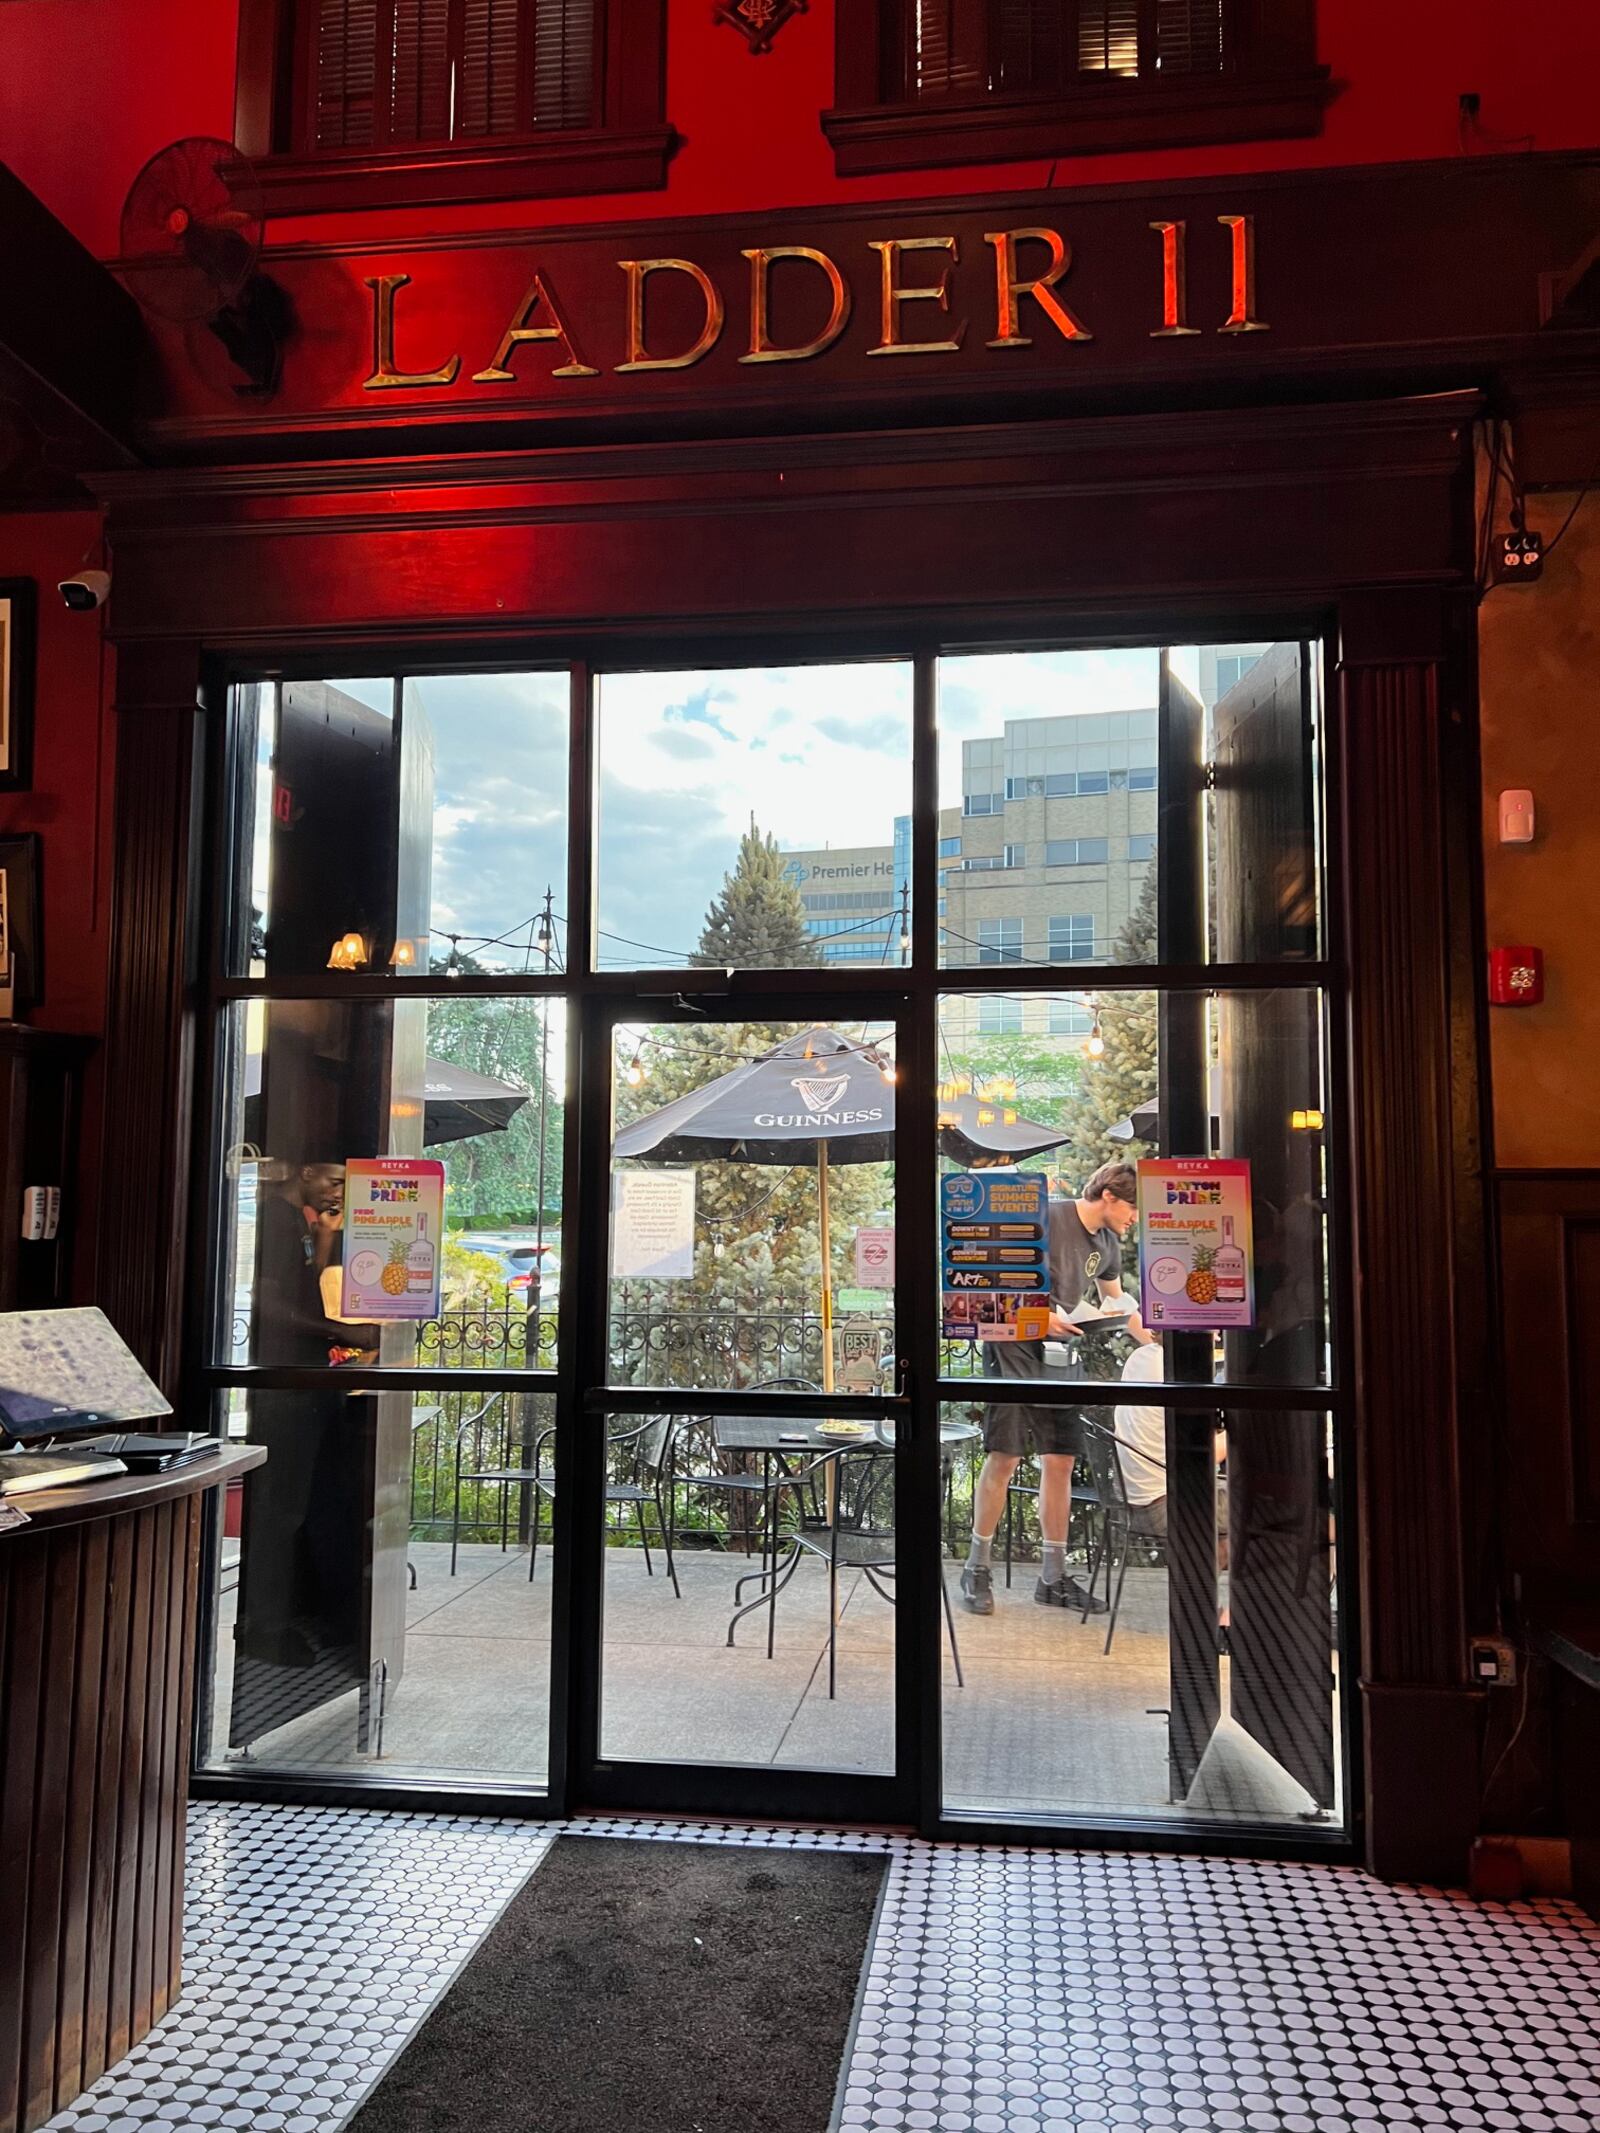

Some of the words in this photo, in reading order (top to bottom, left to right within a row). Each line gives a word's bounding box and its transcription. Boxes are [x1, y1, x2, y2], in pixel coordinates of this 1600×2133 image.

[363, 228, 1094, 391] LADDER
[812, 863, 871, 879] Premier
[754, 1108, 883, 1127] GUINNESS
[1177, 1162, 1210, 1170] REYKA
[371, 1180, 419, 1189] DAYTON
[990, 1184, 1039, 1192] SIGNATURE
[1166, 1181, 1221, 1191] DAYTON
[370, 1189, 419, 1202] PRIDE
[990, 1192, 1039, 1202] SUMMER
[1167, 1191, 1221, 1205] PRIDE
[353, 1208, 375, 1216] PRIDE
[990, 1202, 1039, 1213] EVENTS!
[353, 1216, 412, 1225] PINEAPPLE
[1149, 1220, 1216, 1229] PINEAPPLE
[953, 1272, 984, 1286] ART
[845, 1334, 875, 1349] BEST
